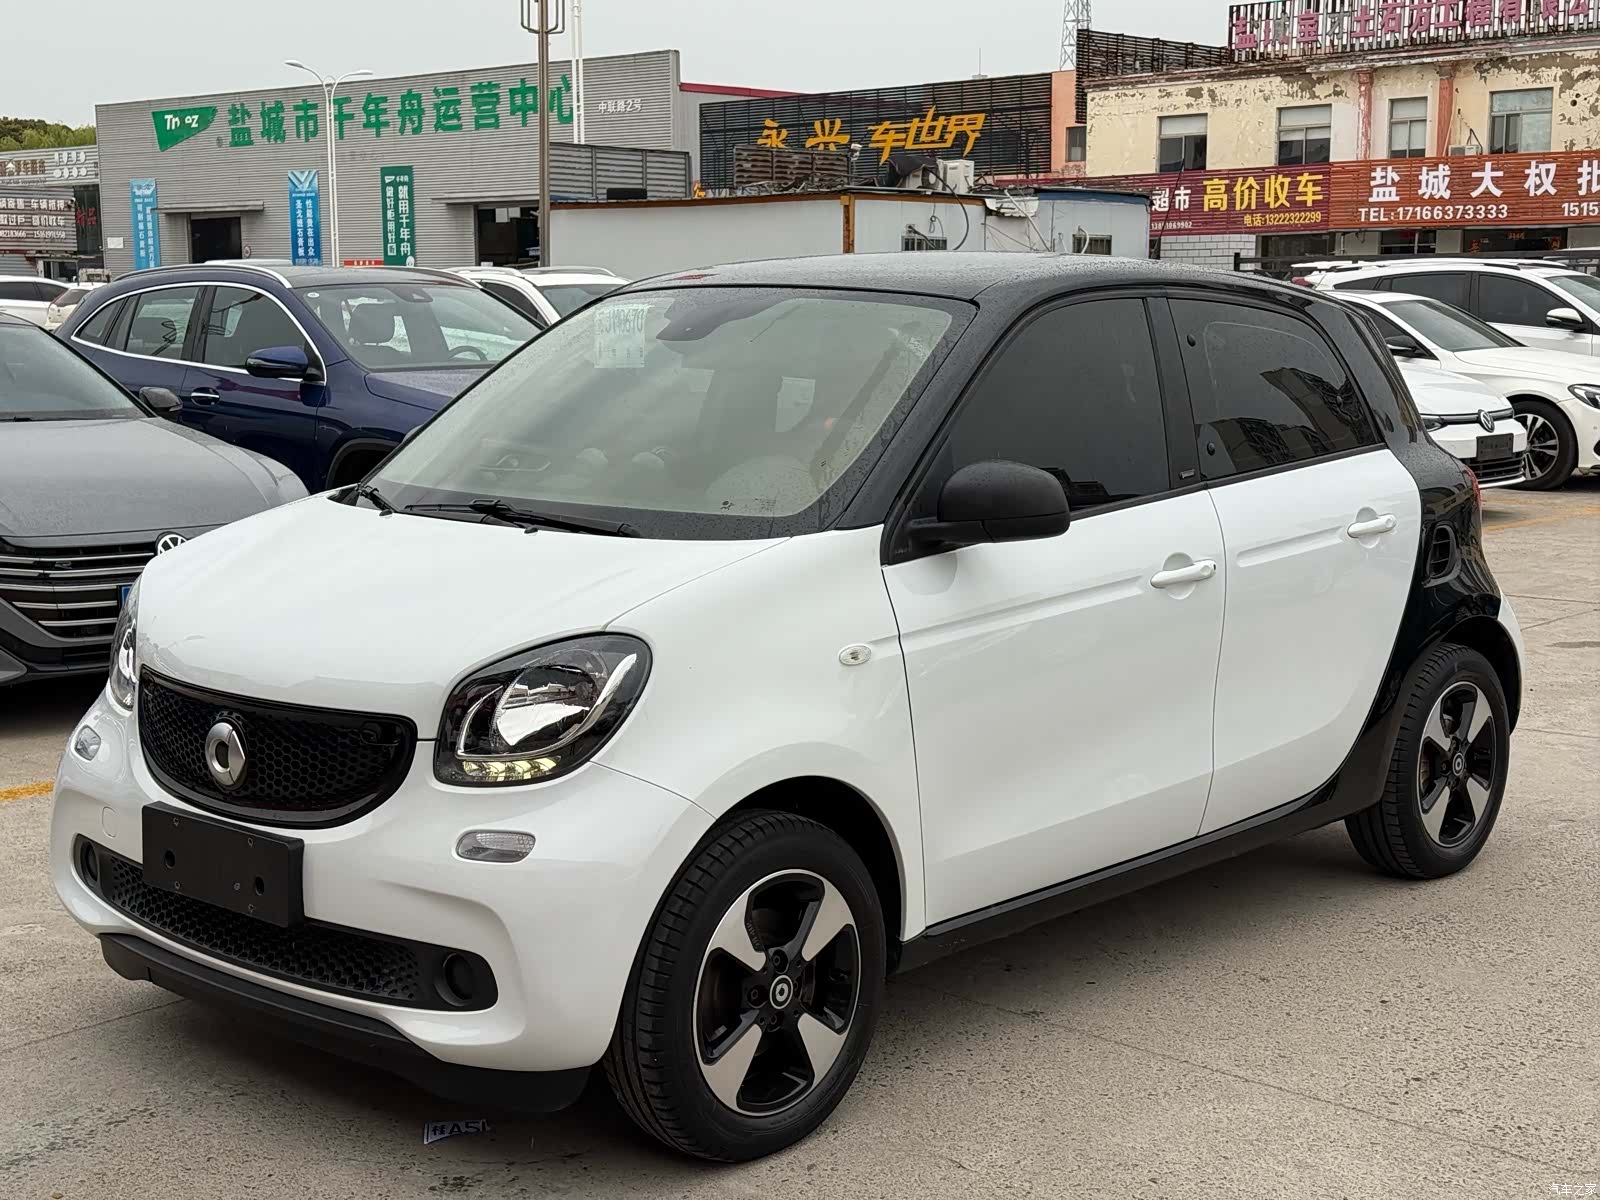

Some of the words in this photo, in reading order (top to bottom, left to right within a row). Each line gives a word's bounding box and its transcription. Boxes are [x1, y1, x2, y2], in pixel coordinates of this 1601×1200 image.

[1202, 172, 1324, 212] 高价收车
[1243, 211, 1322, 227] 电话:13222322299
[1358, 204, 1509, 222] TEL:17166373333
